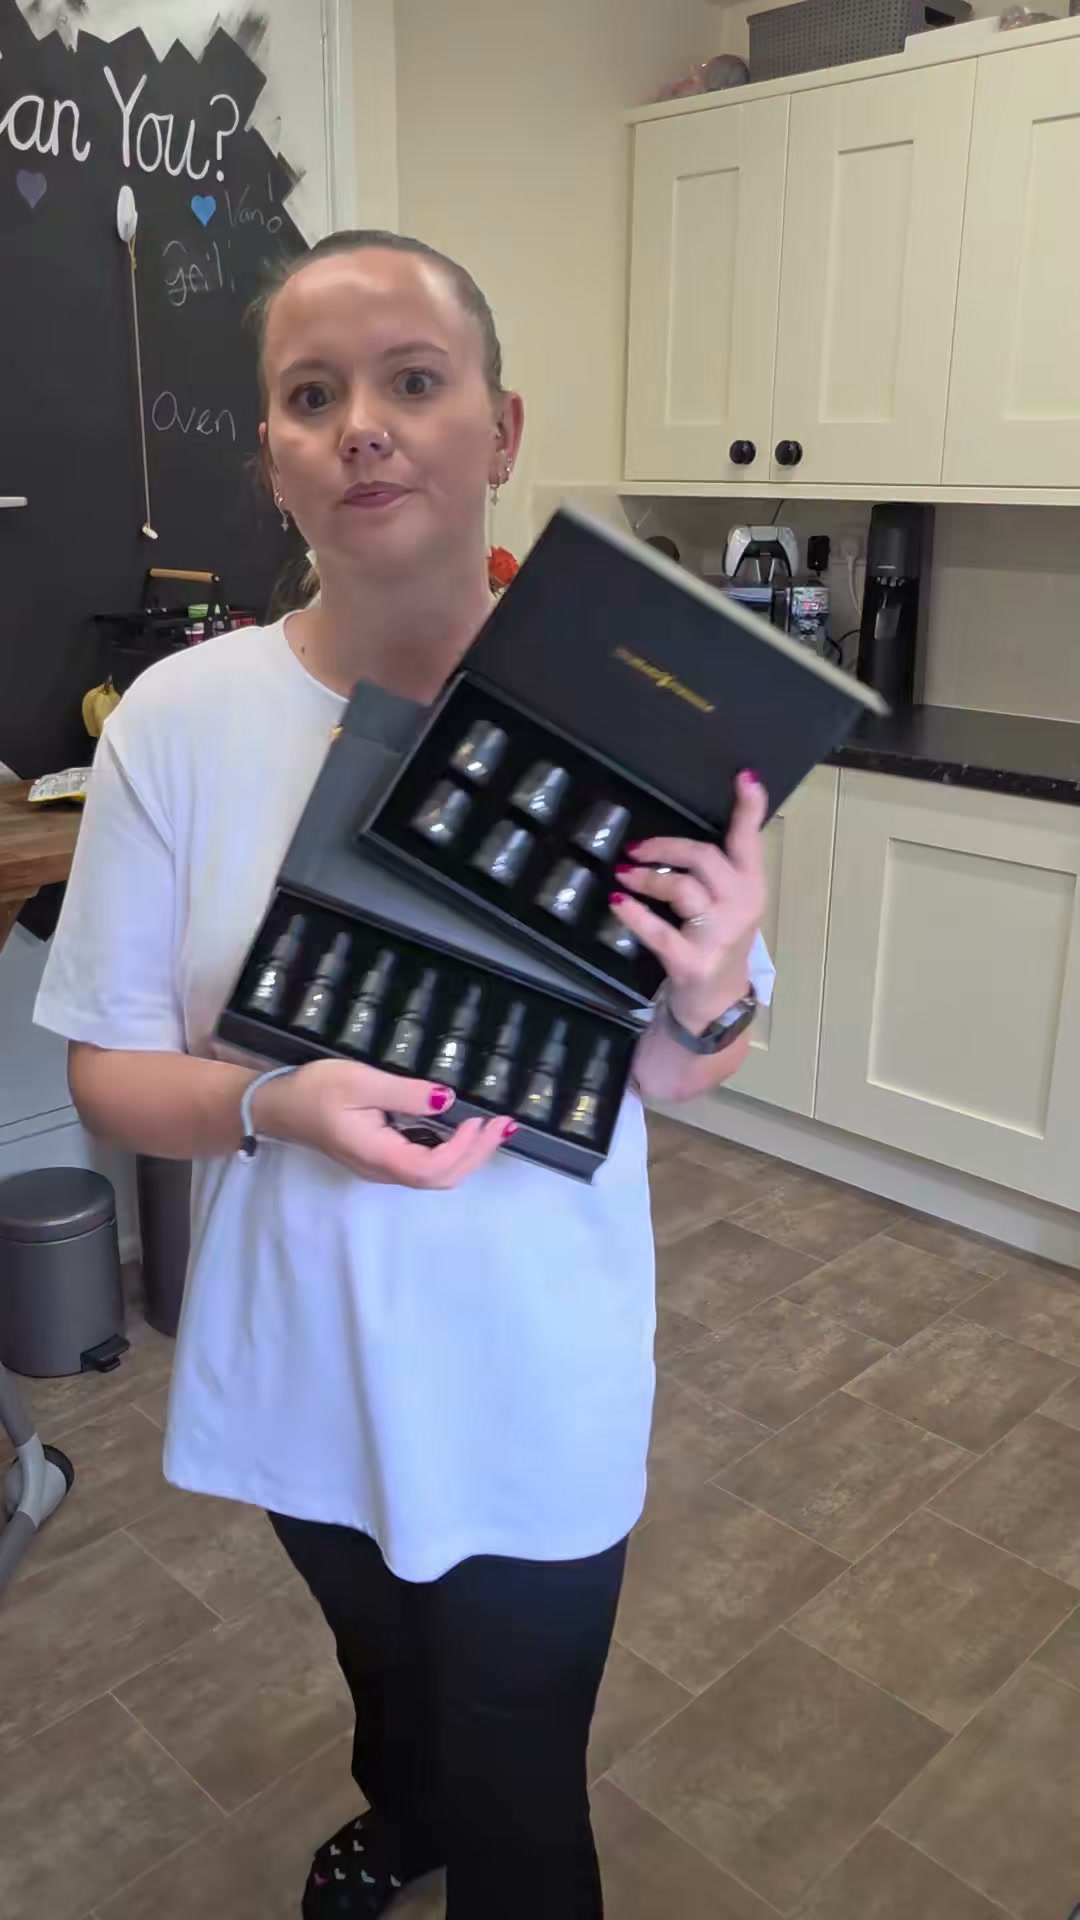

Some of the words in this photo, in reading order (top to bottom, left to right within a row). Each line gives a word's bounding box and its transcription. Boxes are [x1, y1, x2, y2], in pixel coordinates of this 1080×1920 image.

[0, 95, 90, 162] an
[104, 66, 240, 182] You?
[152, 390, 236, 442] Oven
